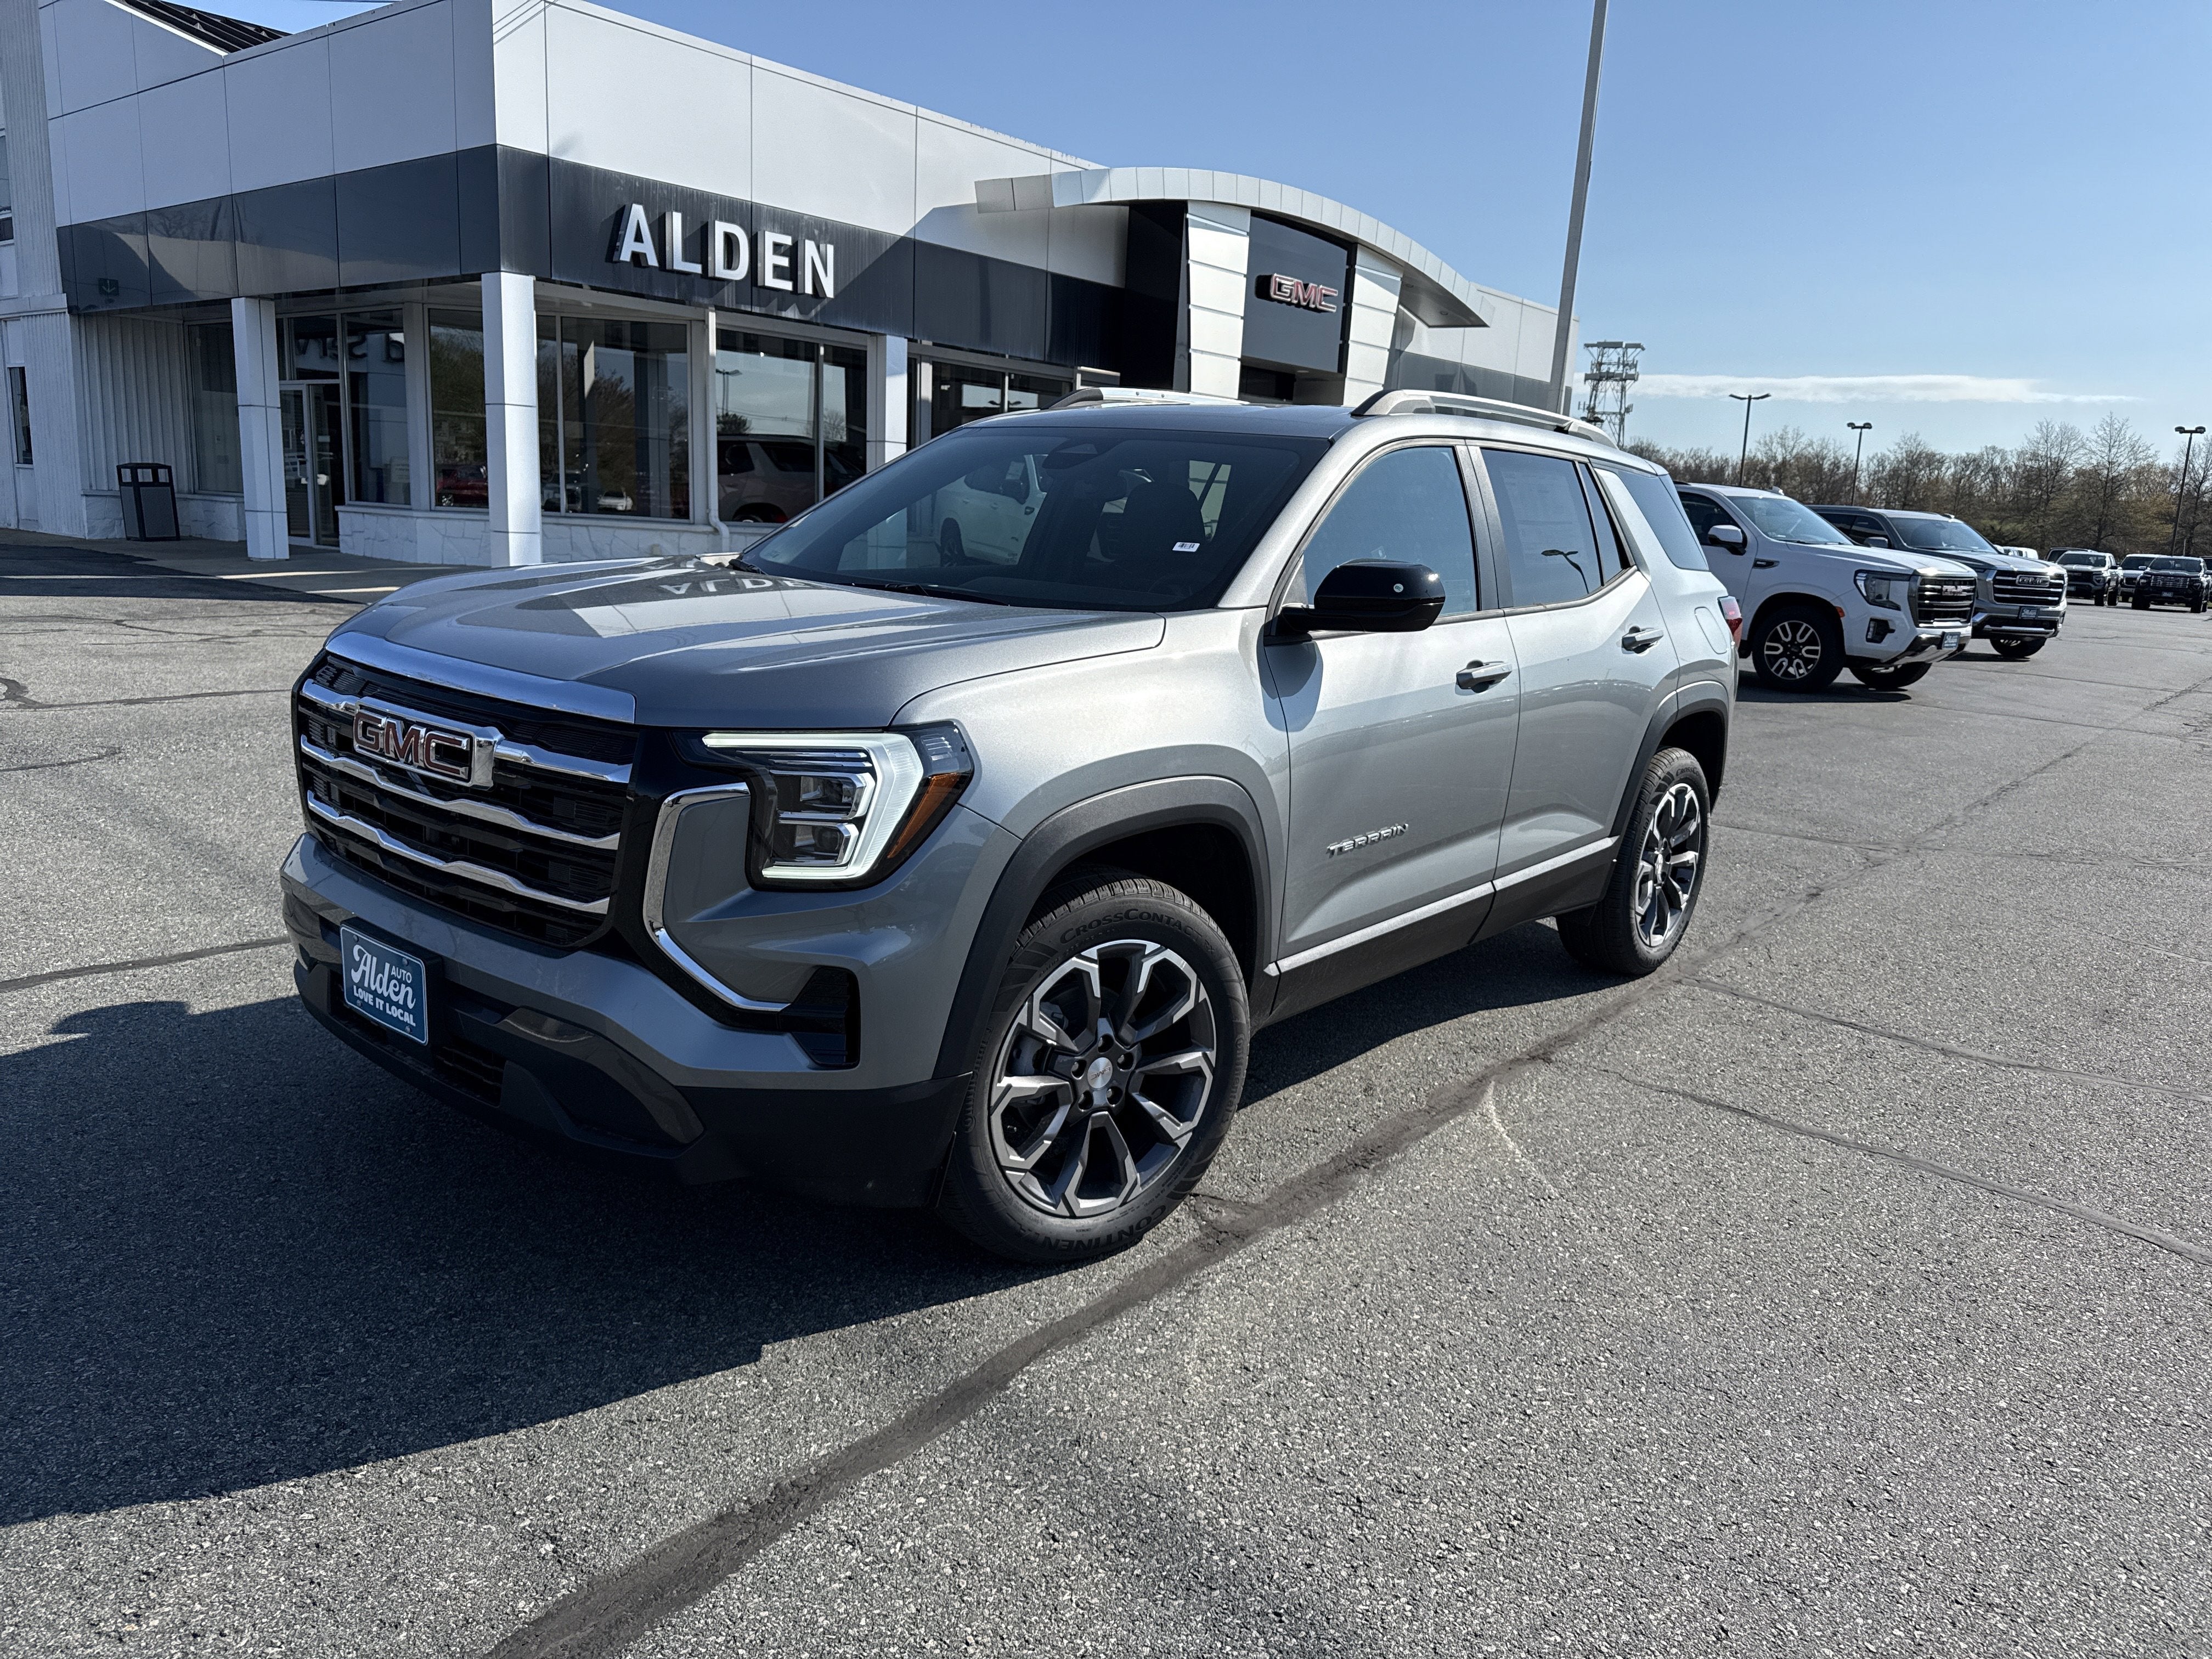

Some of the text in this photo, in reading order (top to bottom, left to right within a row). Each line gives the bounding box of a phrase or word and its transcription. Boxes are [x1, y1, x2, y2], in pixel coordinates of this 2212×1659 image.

[616, 203, 834, 298] ALDEN
[1271, 273, 1339, 313] GMC
[2019, 577, 2050, 586] GMC
[353, 709, 470, 780] GMC
[1328, 823, 1409, 856] TERRAIN
[351, 944, 416, 1009] Alden
[391, 966, 411, 984] AUTO
[353, 985, 416, 1027] LOVE IT LOCAL
[1090, 1066, 1110, 1080] GMC
